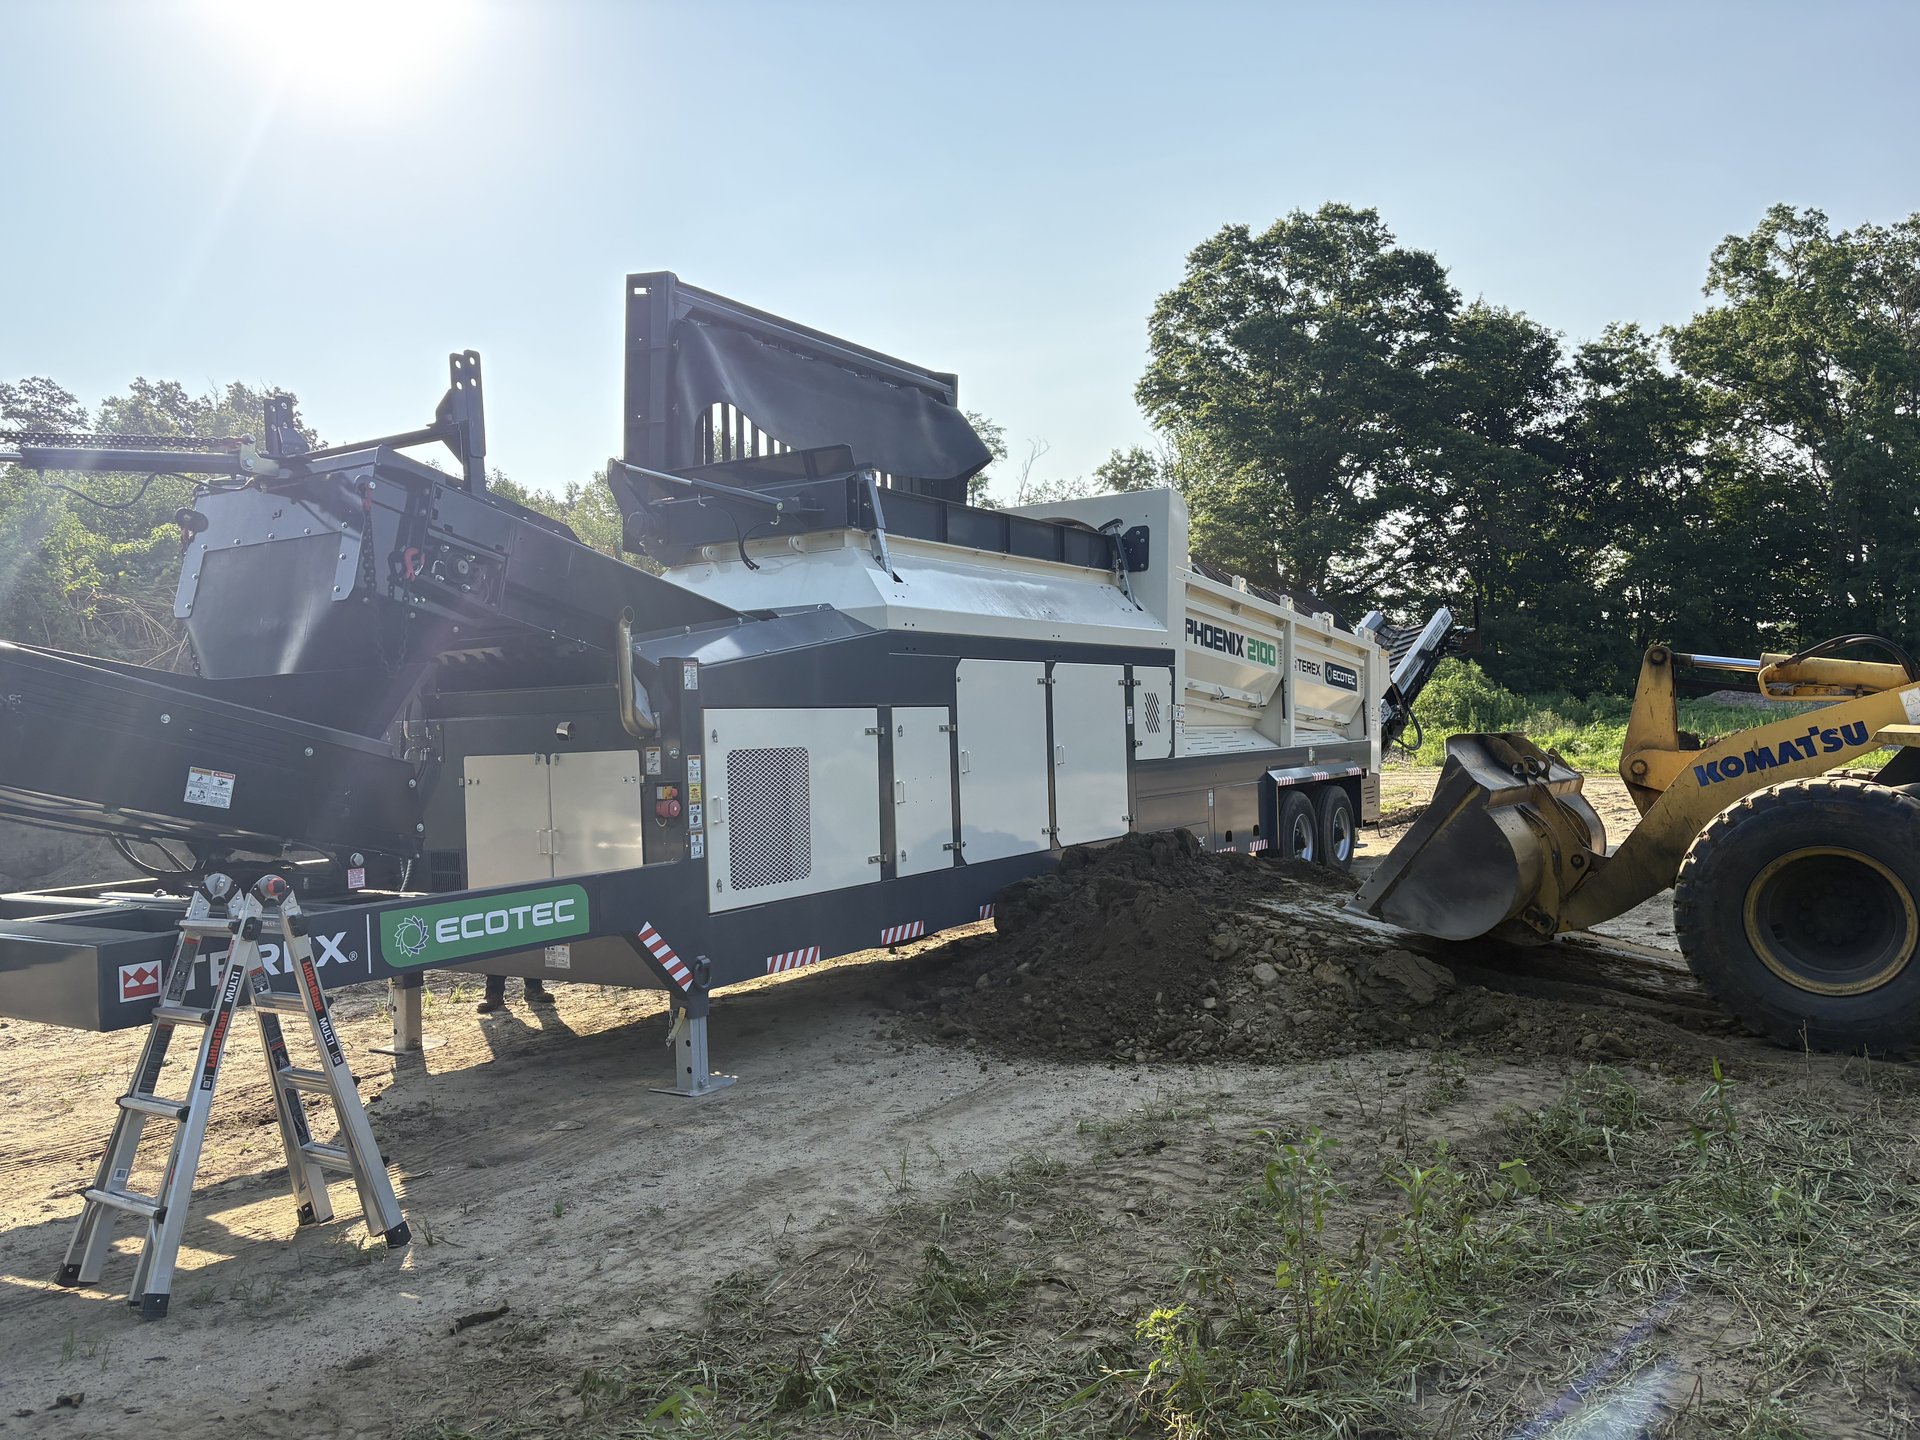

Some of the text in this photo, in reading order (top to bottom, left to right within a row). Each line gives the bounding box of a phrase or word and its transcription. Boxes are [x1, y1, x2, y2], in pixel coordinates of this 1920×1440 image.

[1185, 617, 1276, 667] PHOENIX 2100
[1297, 658, 1321, 677] TEREX
[1332, 669, 1356, 686] ECOTEC
[1693, 720, 1869, 787] KOMATSU
[435, 898, 575, 944] ECOTEC
[224, 970, 241, 1003] MULTI
[319, 1016, 335, 1047] MULTI
